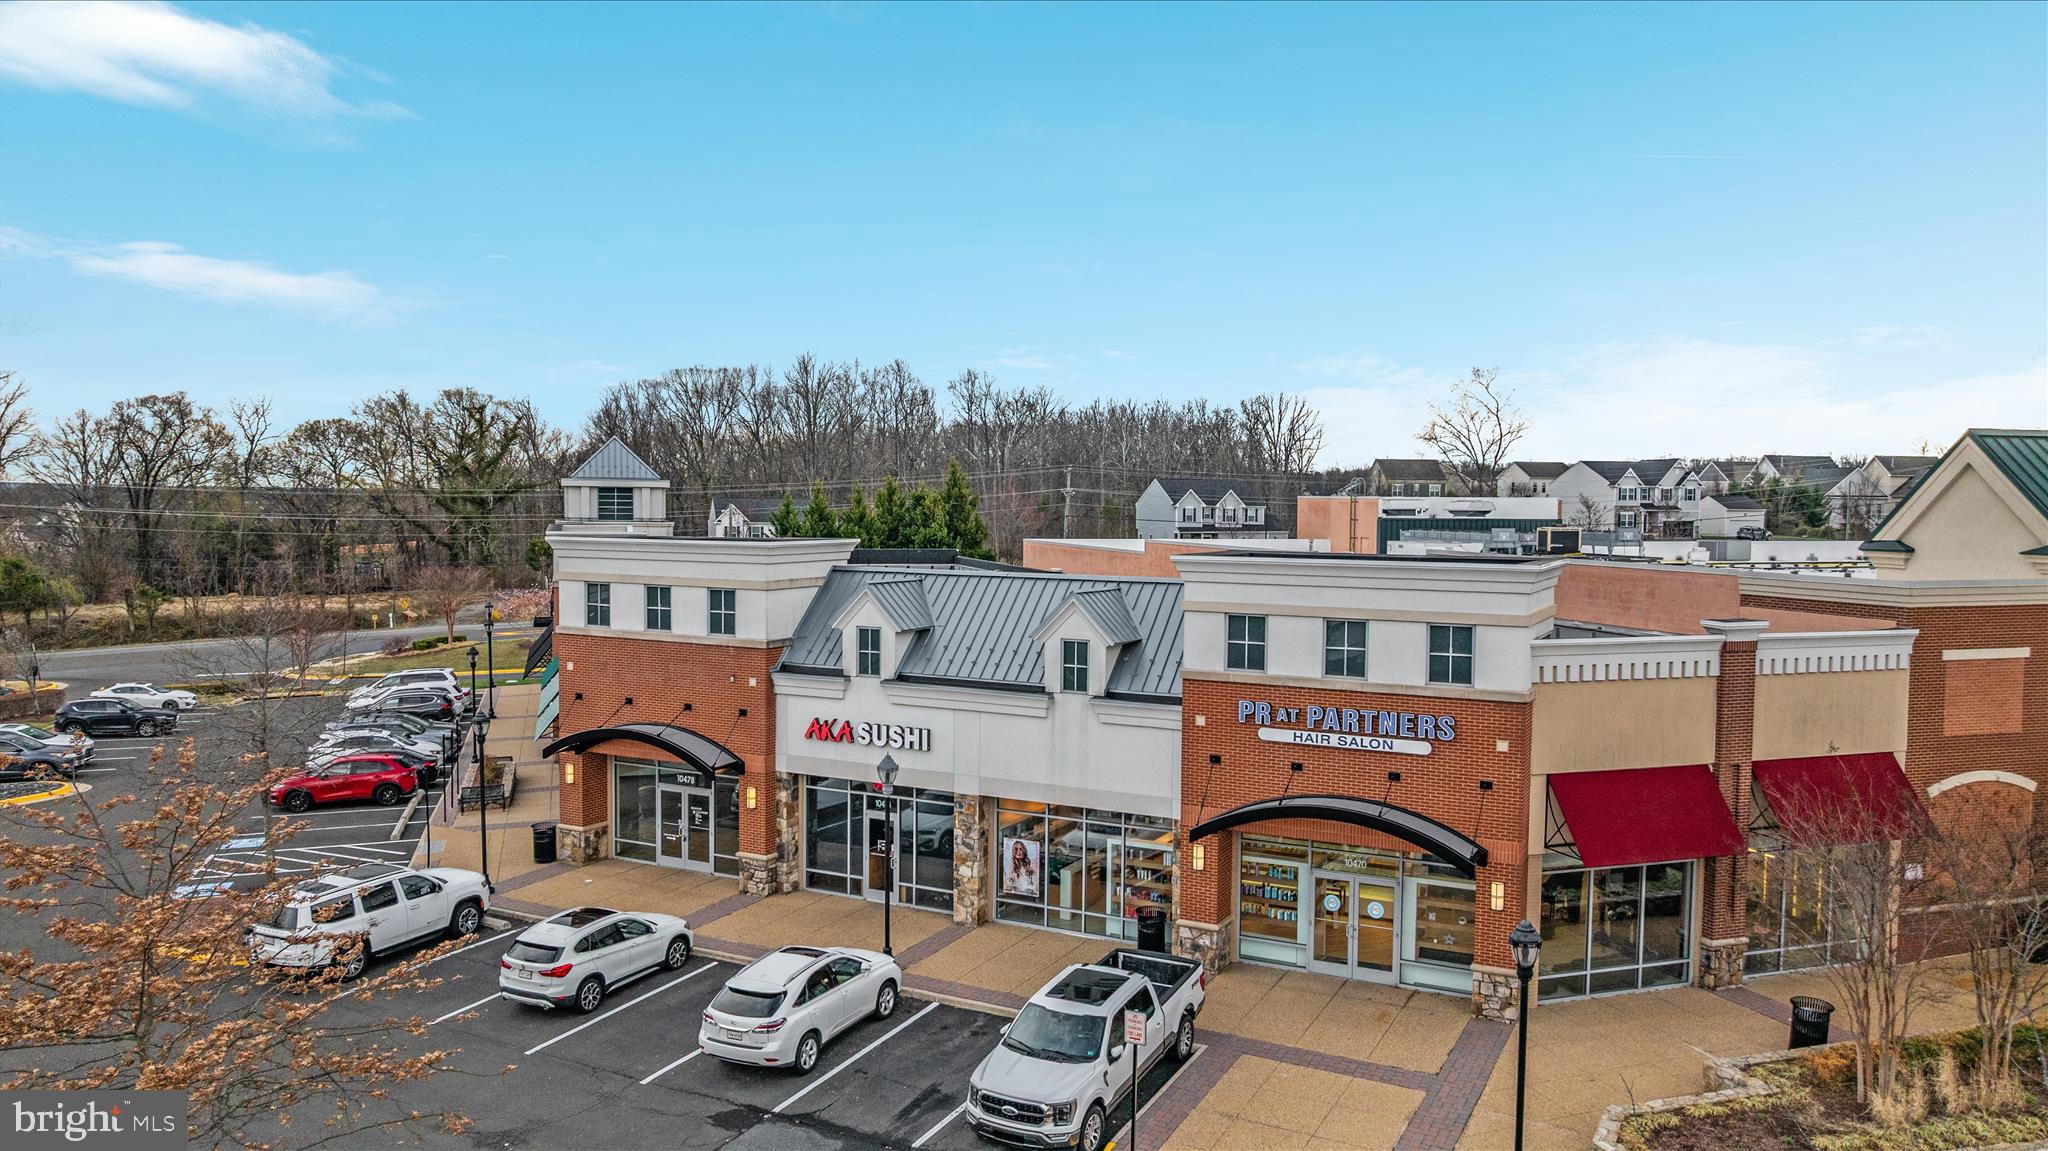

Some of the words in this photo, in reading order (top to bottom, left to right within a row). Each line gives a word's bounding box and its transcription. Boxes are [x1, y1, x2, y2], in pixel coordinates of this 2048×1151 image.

[1238, 700, 1272, 725] PR
[1276, 707, 1300, 723] AT
[1306, 705, 1456, 741] PARTNERS
[804, 717, 855, 744] AKA
[856, 721, 931, 752] SUSHI
[1293, 732, 1331, 745] HAIR
[1337, 735, 1394, 751] SALON
[676, 774, 695, 785] 10478
[875, 799, 892, 809] 104
[1344, 859, 1367, 869] 10470
